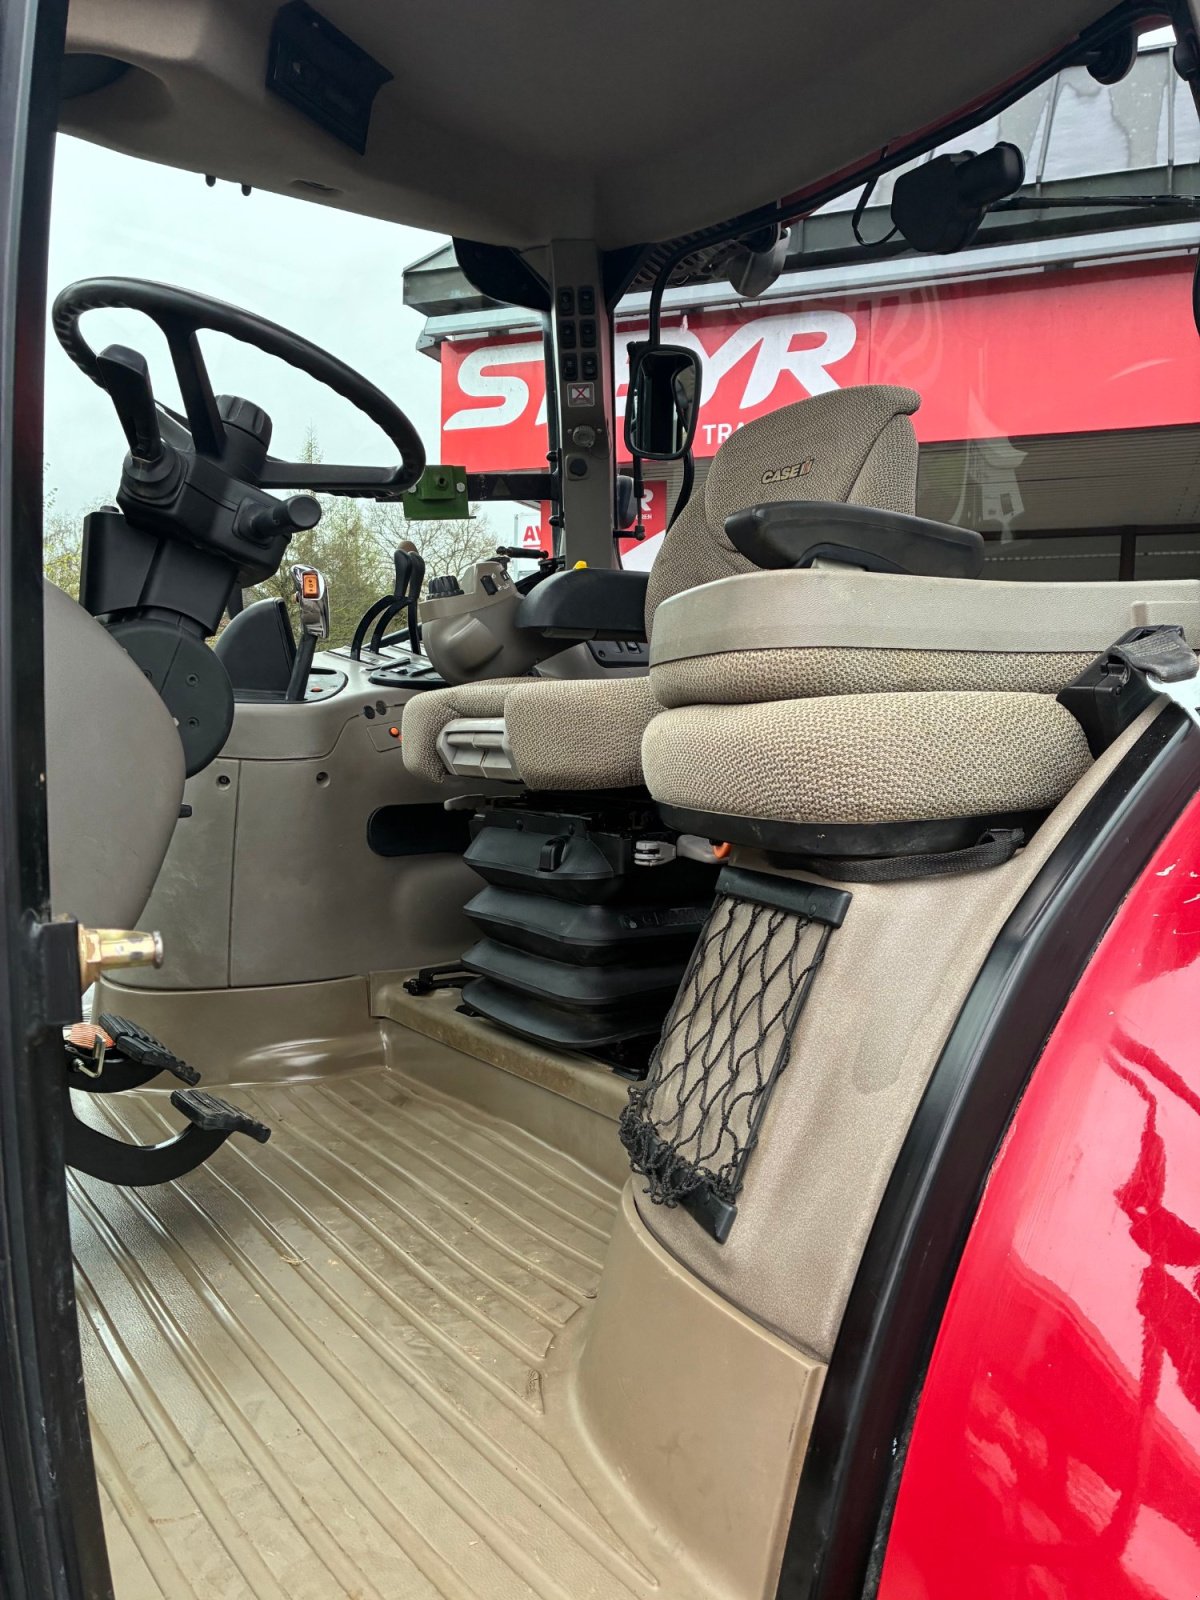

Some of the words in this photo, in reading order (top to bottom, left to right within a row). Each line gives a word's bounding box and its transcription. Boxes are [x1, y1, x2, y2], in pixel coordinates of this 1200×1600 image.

[442, 310, 857, 431] SYR
[702, 422, 745, 445] TR
[761, 463, 801, 485] CASE
